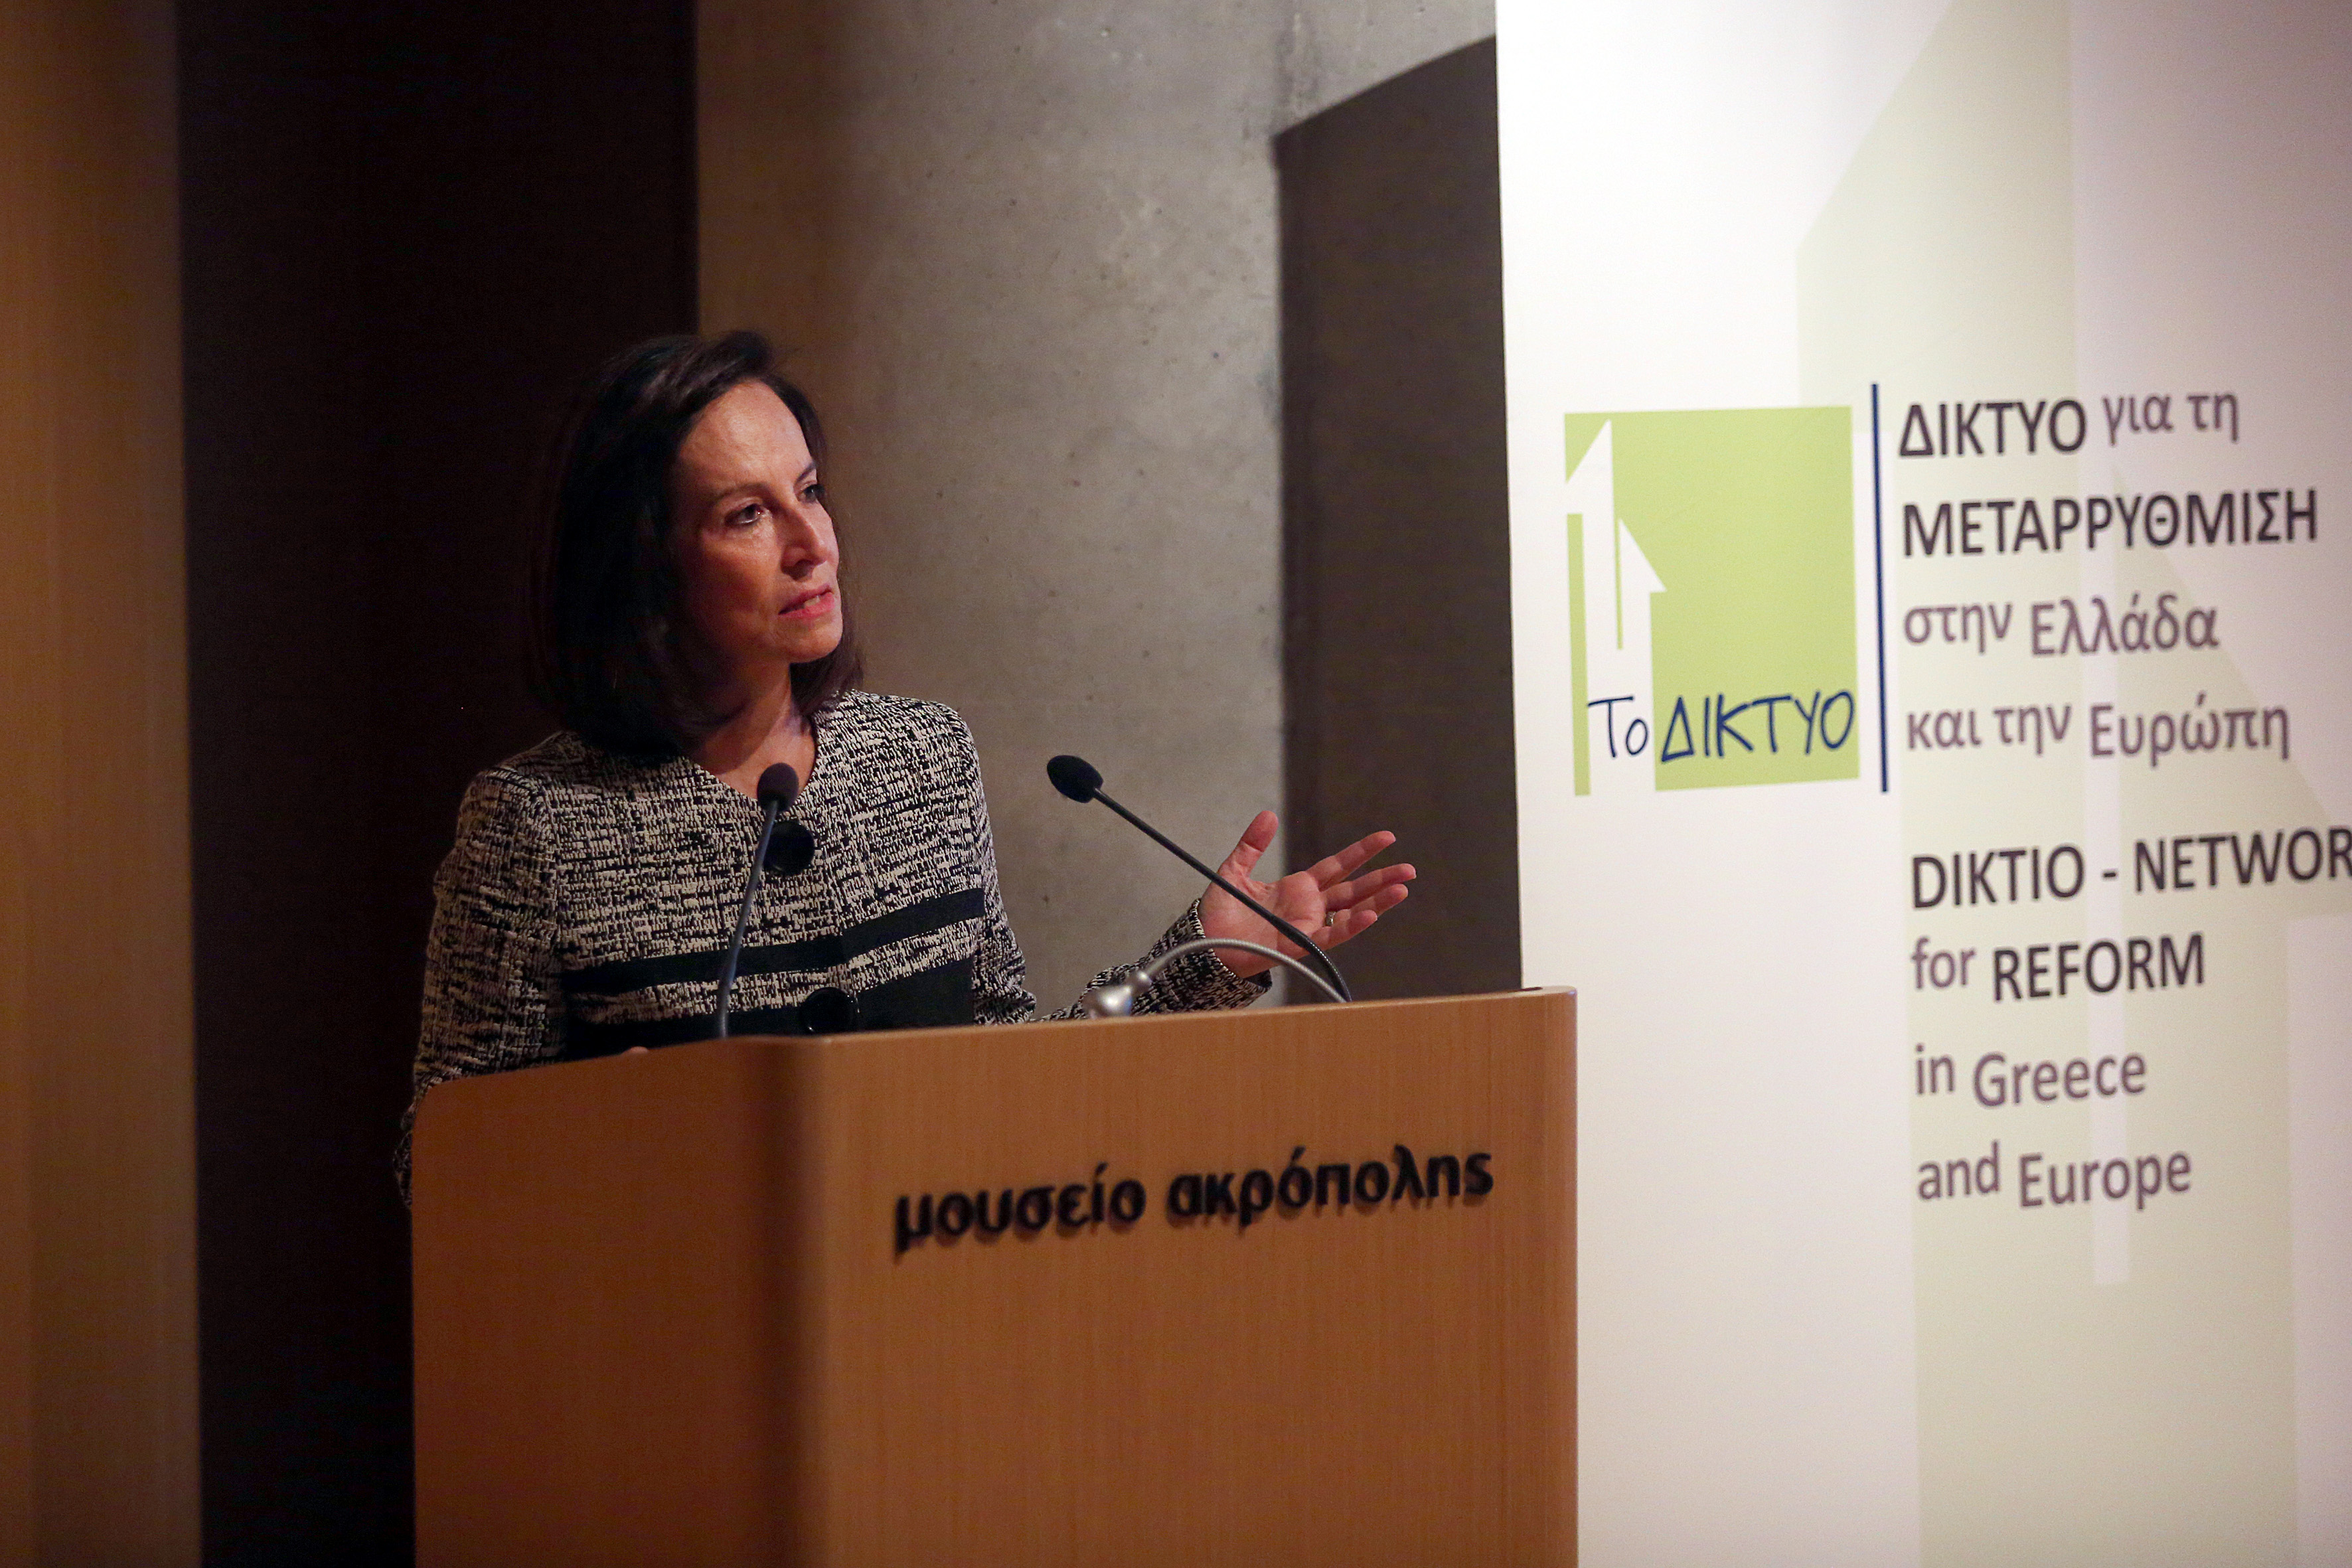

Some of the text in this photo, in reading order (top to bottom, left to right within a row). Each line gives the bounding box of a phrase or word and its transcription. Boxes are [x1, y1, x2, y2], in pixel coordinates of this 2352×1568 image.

[1899, 393, 2238, 457] ΔΙΚΤΥΟ για τη
[1904, 489, 2317, 556] ΜΕΤΑΡΡΥΘΜΙΣΗ
[1904, 592, 2219, 657] στην Ελλάδα
[1661, 690, 1854, 763] ΔΙΚΤΥΟ
[1907, 692, 2289, 768] και την Ευρώπη
[1912, 844, 2084, 909] DIKTIO
[2135, 826, 2352, 893] NETWOR
[1912, 933, 2205, 1002] for REFORM
[1915, 1043, 2146, 1107] in Greece
[894, 1162, 1146, 1254] μουσείο
[1918, 1140, 2191, 1211] and Europe
